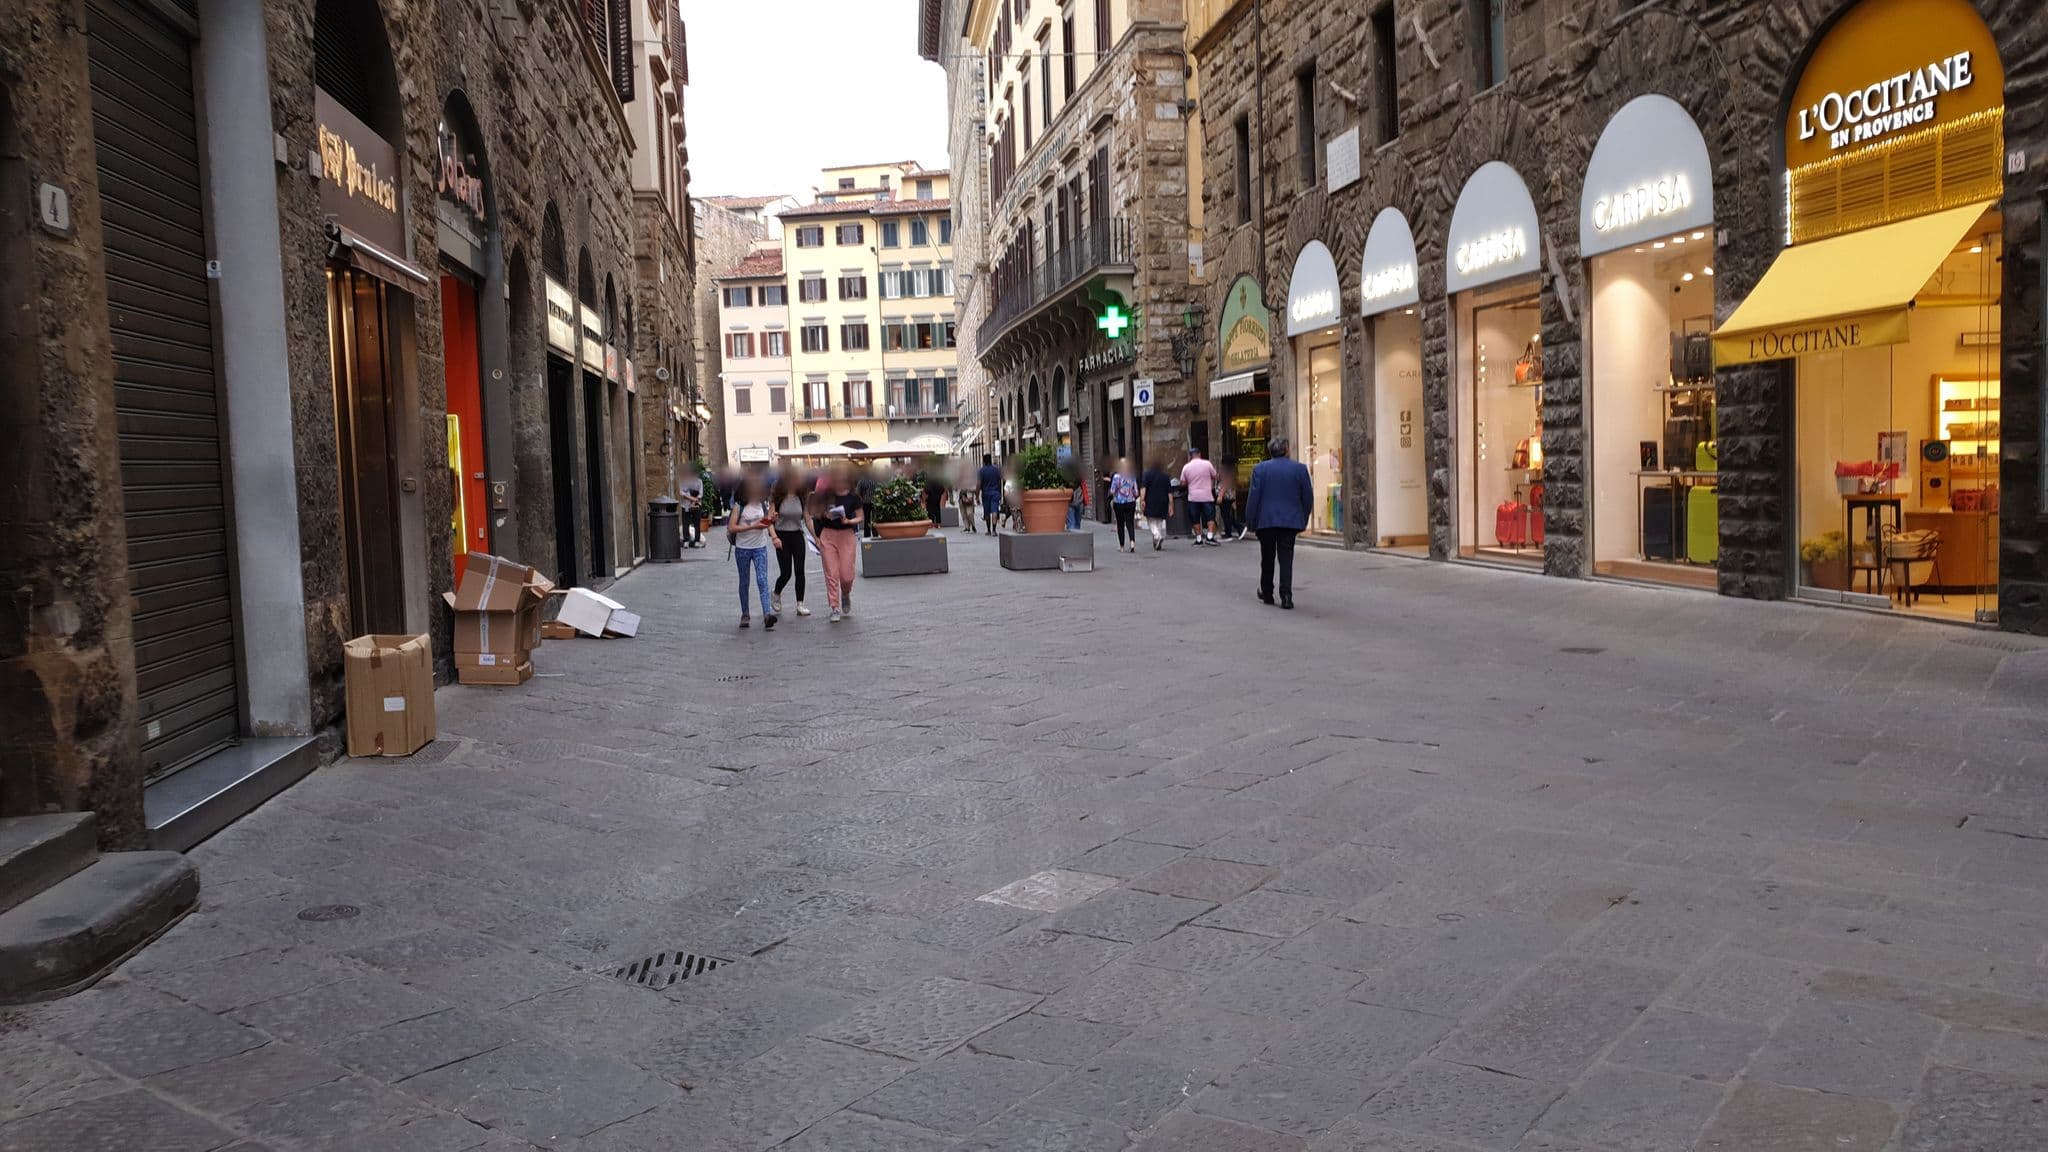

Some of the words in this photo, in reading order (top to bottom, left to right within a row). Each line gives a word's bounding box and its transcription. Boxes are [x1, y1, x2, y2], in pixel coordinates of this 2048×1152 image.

[1830, 128, 1850, 149] EN
[1854, 102, 1934, 142] PROVENCE
[1593, 174, 1691, 231] CARPISA
[1456, 226, 1525, 274] CARPISA
[1079, 345, 1124, 374] FARMACIA
